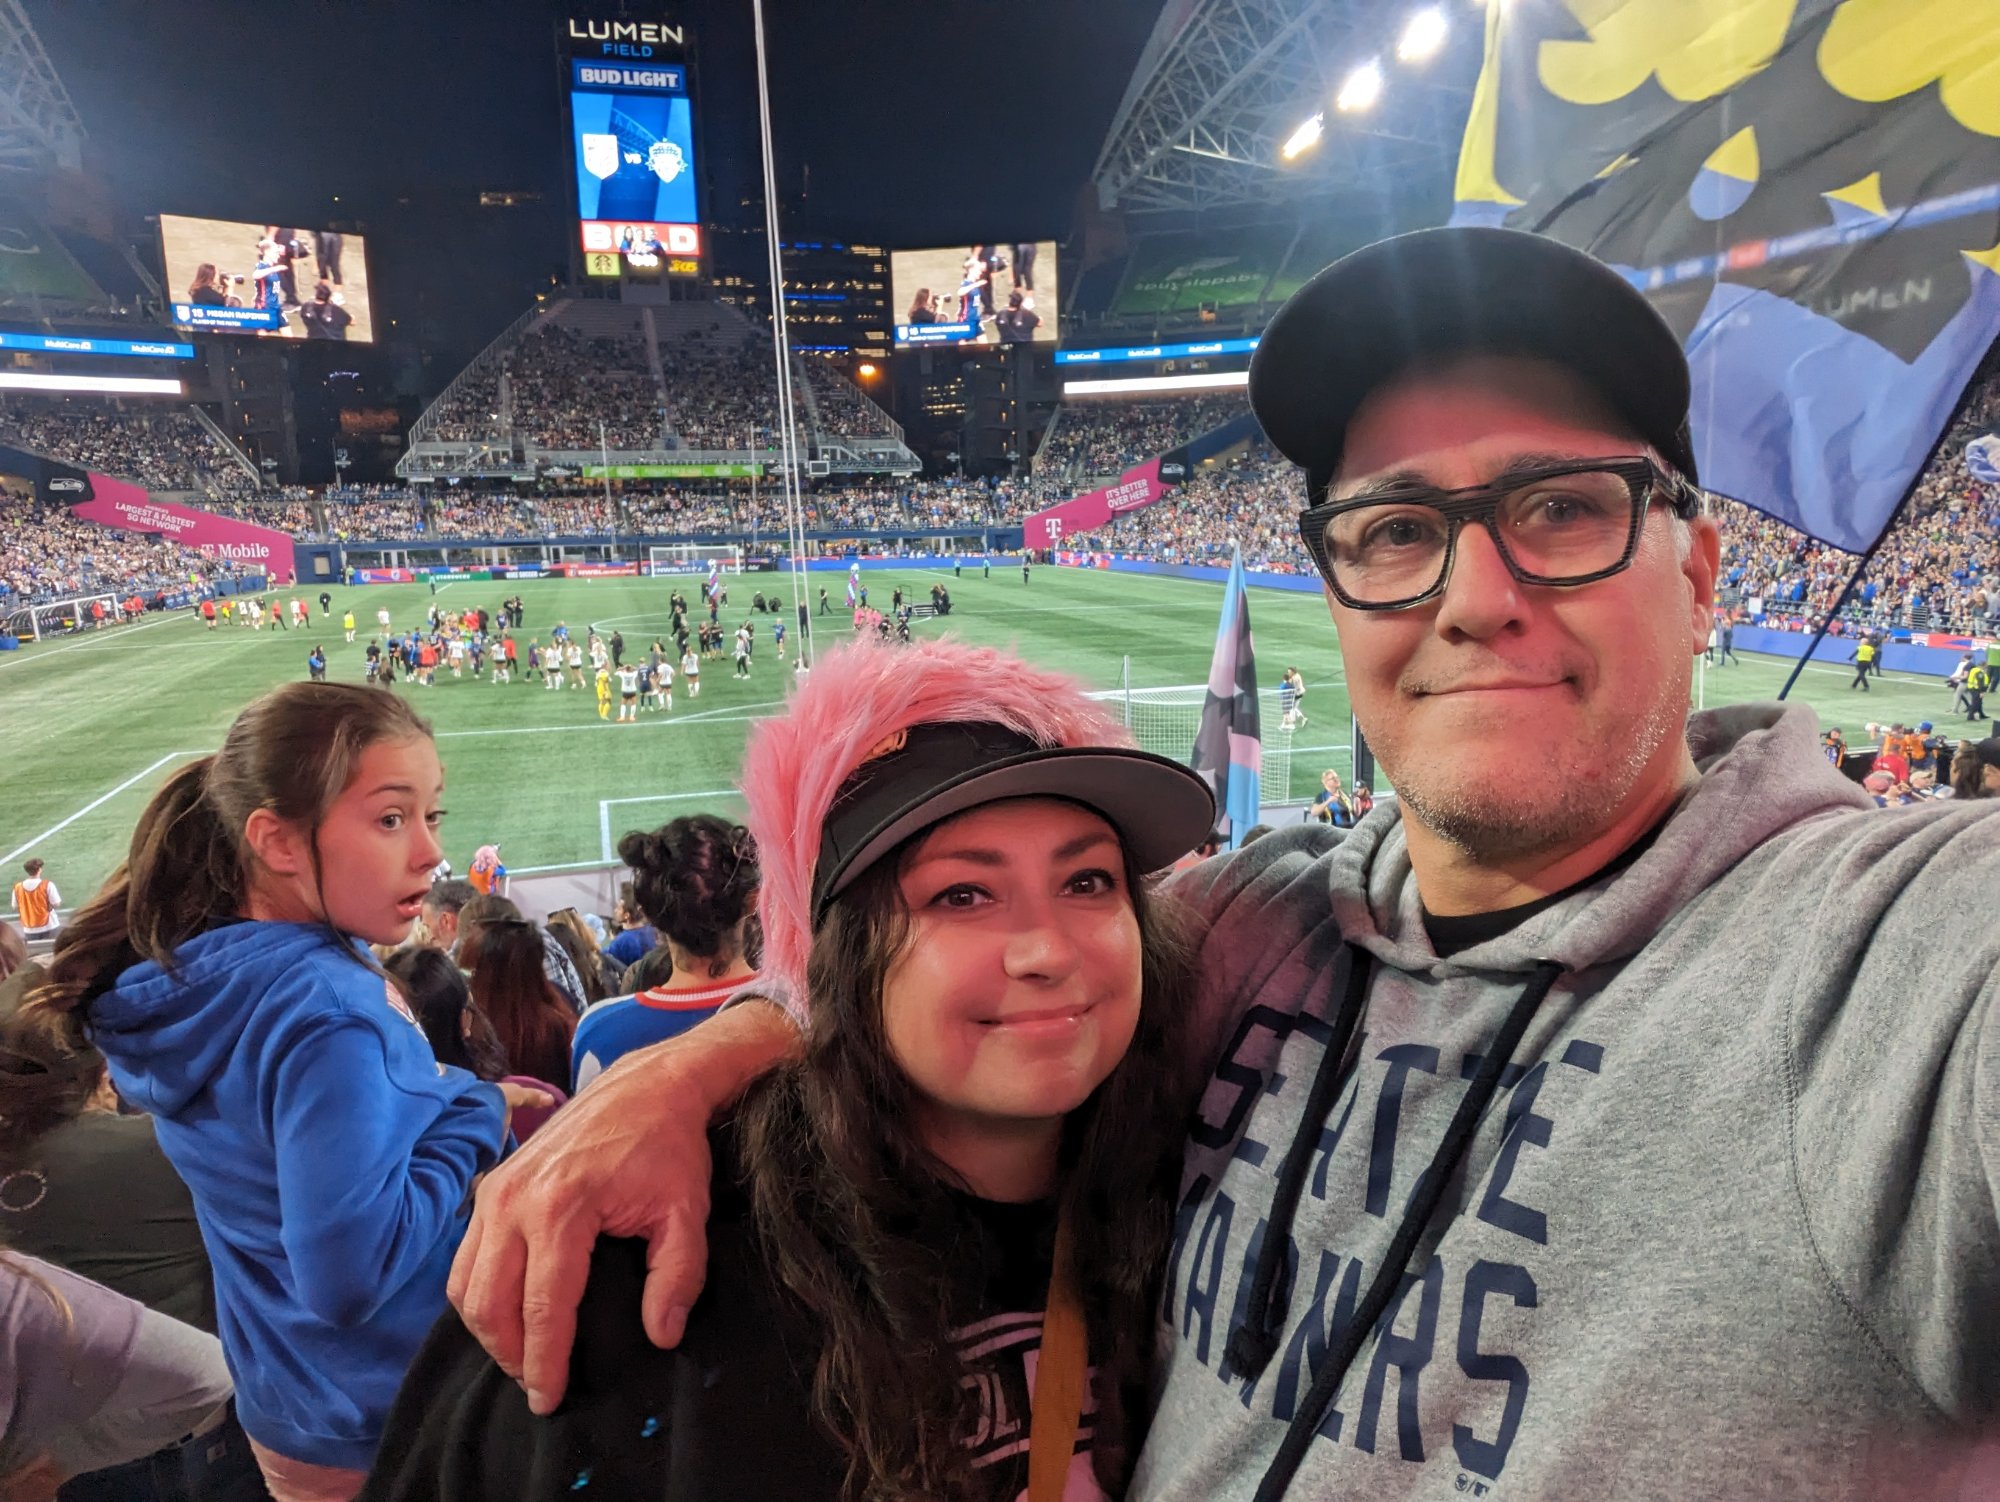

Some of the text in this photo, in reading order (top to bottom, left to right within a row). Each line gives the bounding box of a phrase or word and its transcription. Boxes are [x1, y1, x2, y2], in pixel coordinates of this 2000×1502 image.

[569, 18, 684, 44] LUMEN
[603, 43, 653, 57] FIELD
[580, 68, 678, 88] BUD LIGHT
[583, 223, 697, 252] BD
[1107, 495, 1130, 509] OVER
[1130, 487, 1150, 501] HERE
[1120, 479, 1148, 496] BETTER
[115, 502, 152, 518] LARGEST
[161, 513, 196, 529] FASTEST
[126, 513, 139, 522] 5G
[139, 516, 182, 533] NETWORK
[1045, 518, 1062, 539] T
[218, 543, 269, 558] Mobile
[1189, 1004, 1605, 1246] SATE
[1163, 1174, 1538, 1481] ARNRS
